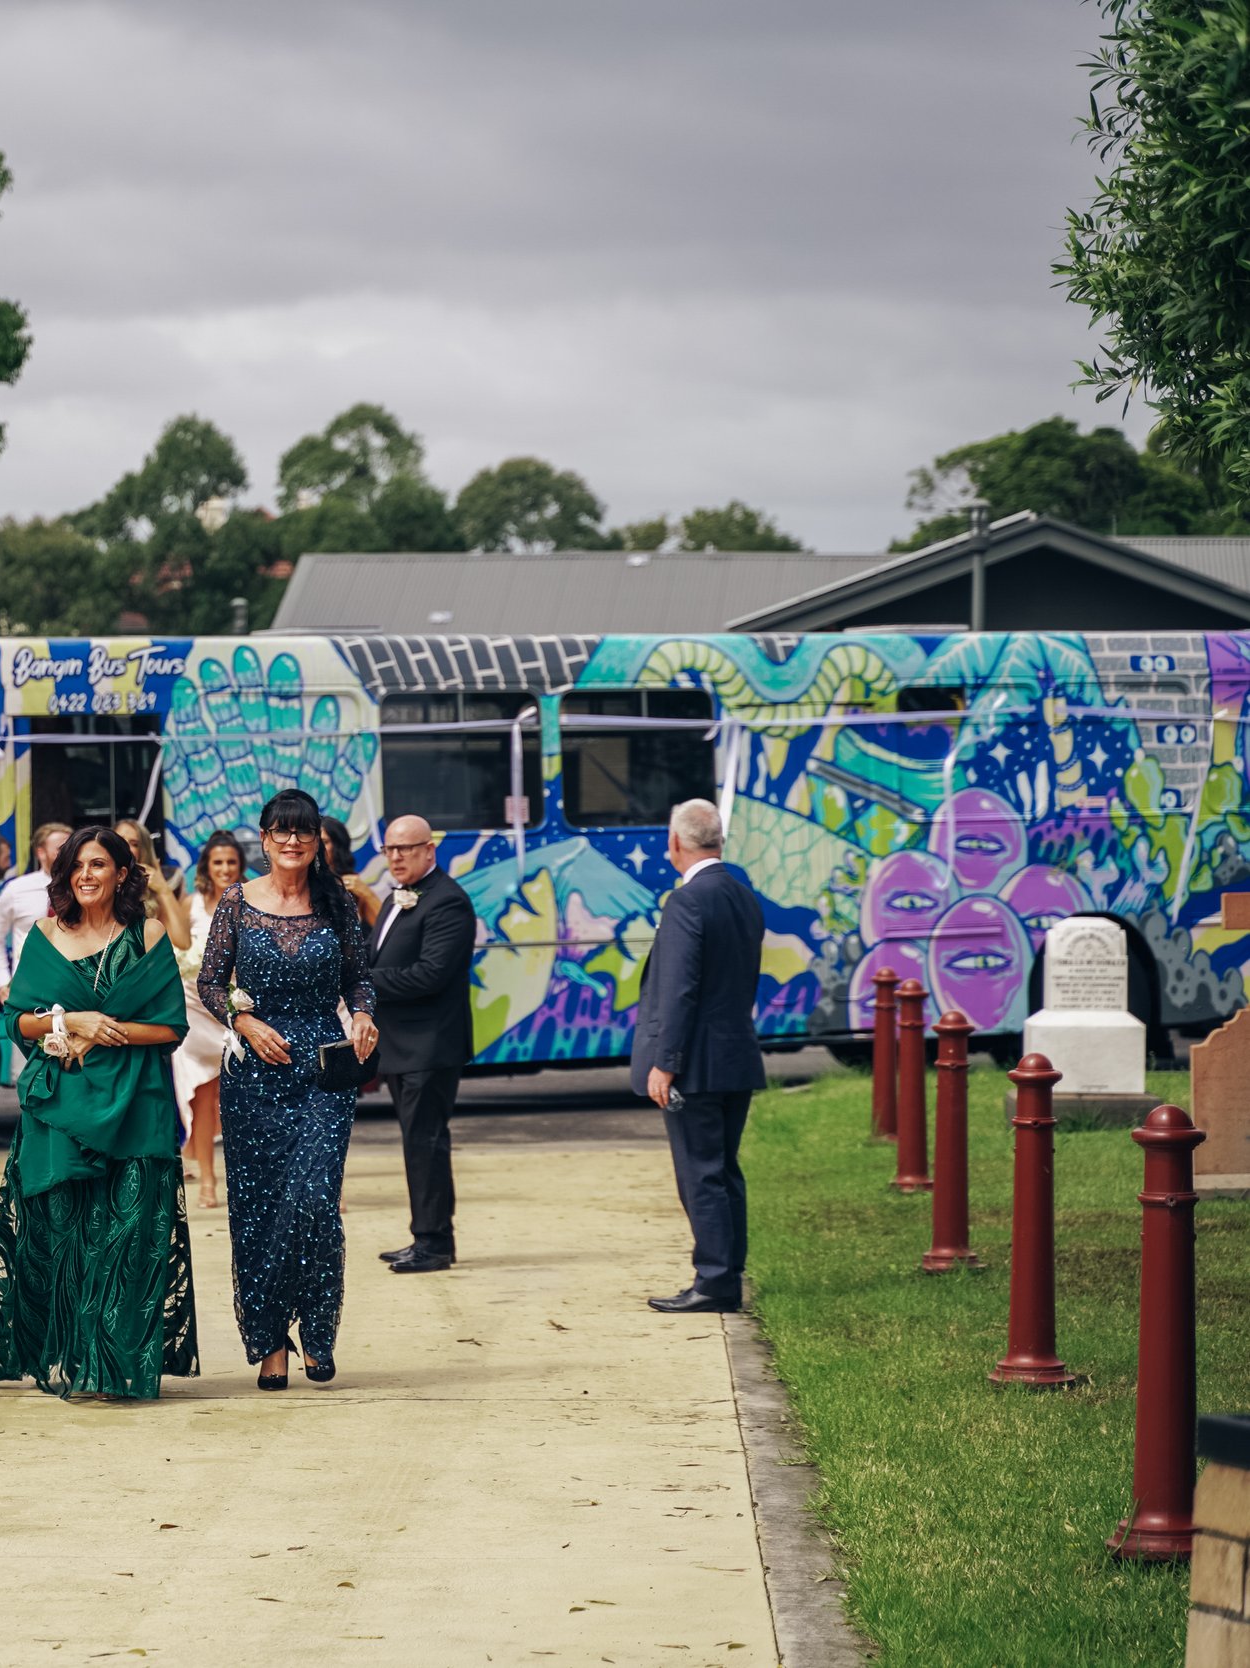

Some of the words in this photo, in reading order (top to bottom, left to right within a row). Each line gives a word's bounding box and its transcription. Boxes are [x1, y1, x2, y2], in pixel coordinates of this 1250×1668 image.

[14, 646, 83, 687] Bangin
[88, 645, 126, 685] Bus
[128, 645, 185, 686] Tours
[49, 692, 87, 713] 0422
